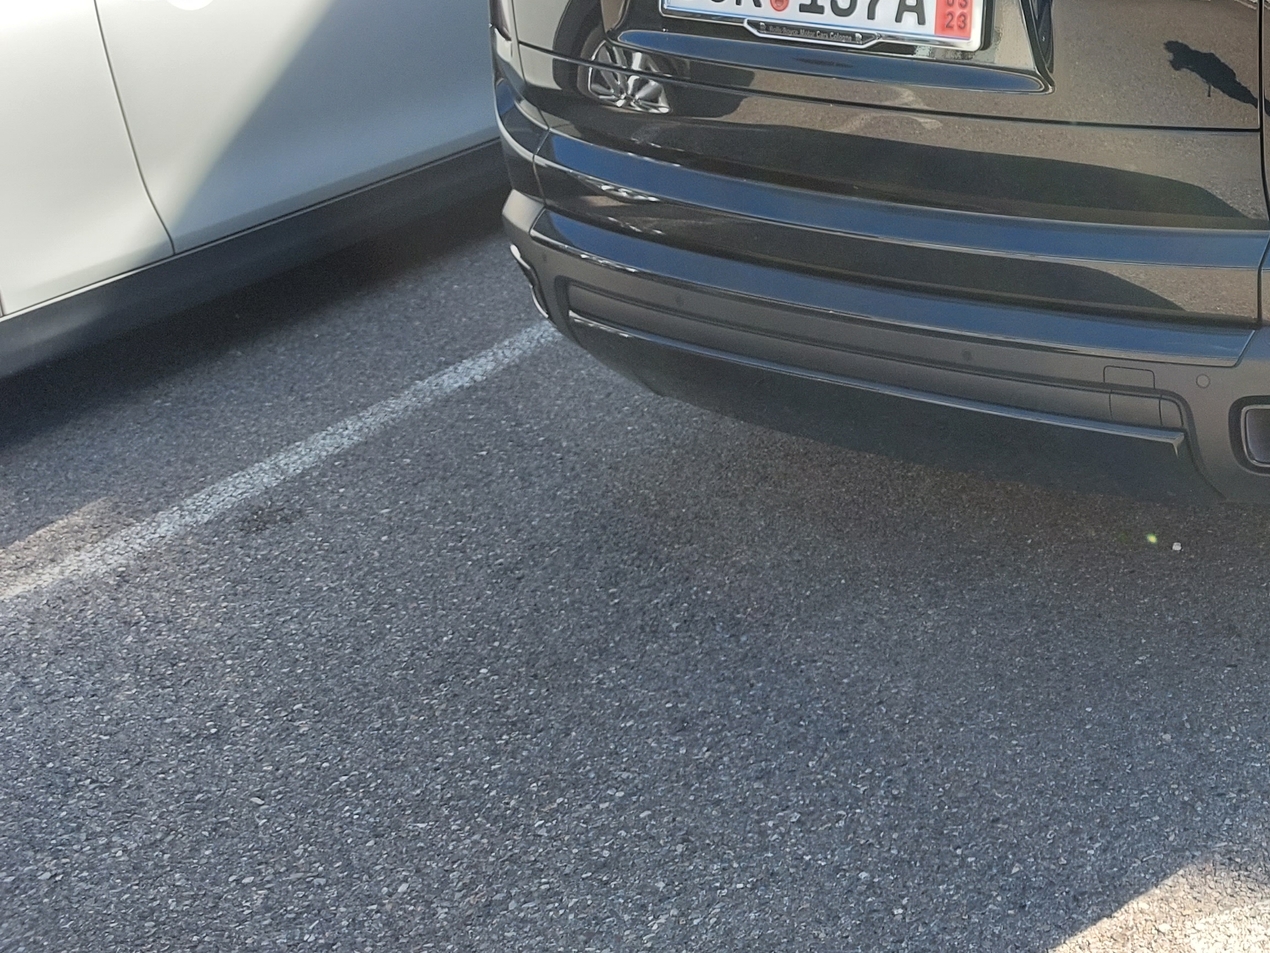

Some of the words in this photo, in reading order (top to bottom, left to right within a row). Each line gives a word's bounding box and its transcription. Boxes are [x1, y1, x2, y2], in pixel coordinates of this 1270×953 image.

[945, 11, 967, 30] 23
[816, 30, 829, 39] Cars
[829, 31, 852, 42] Cologne
